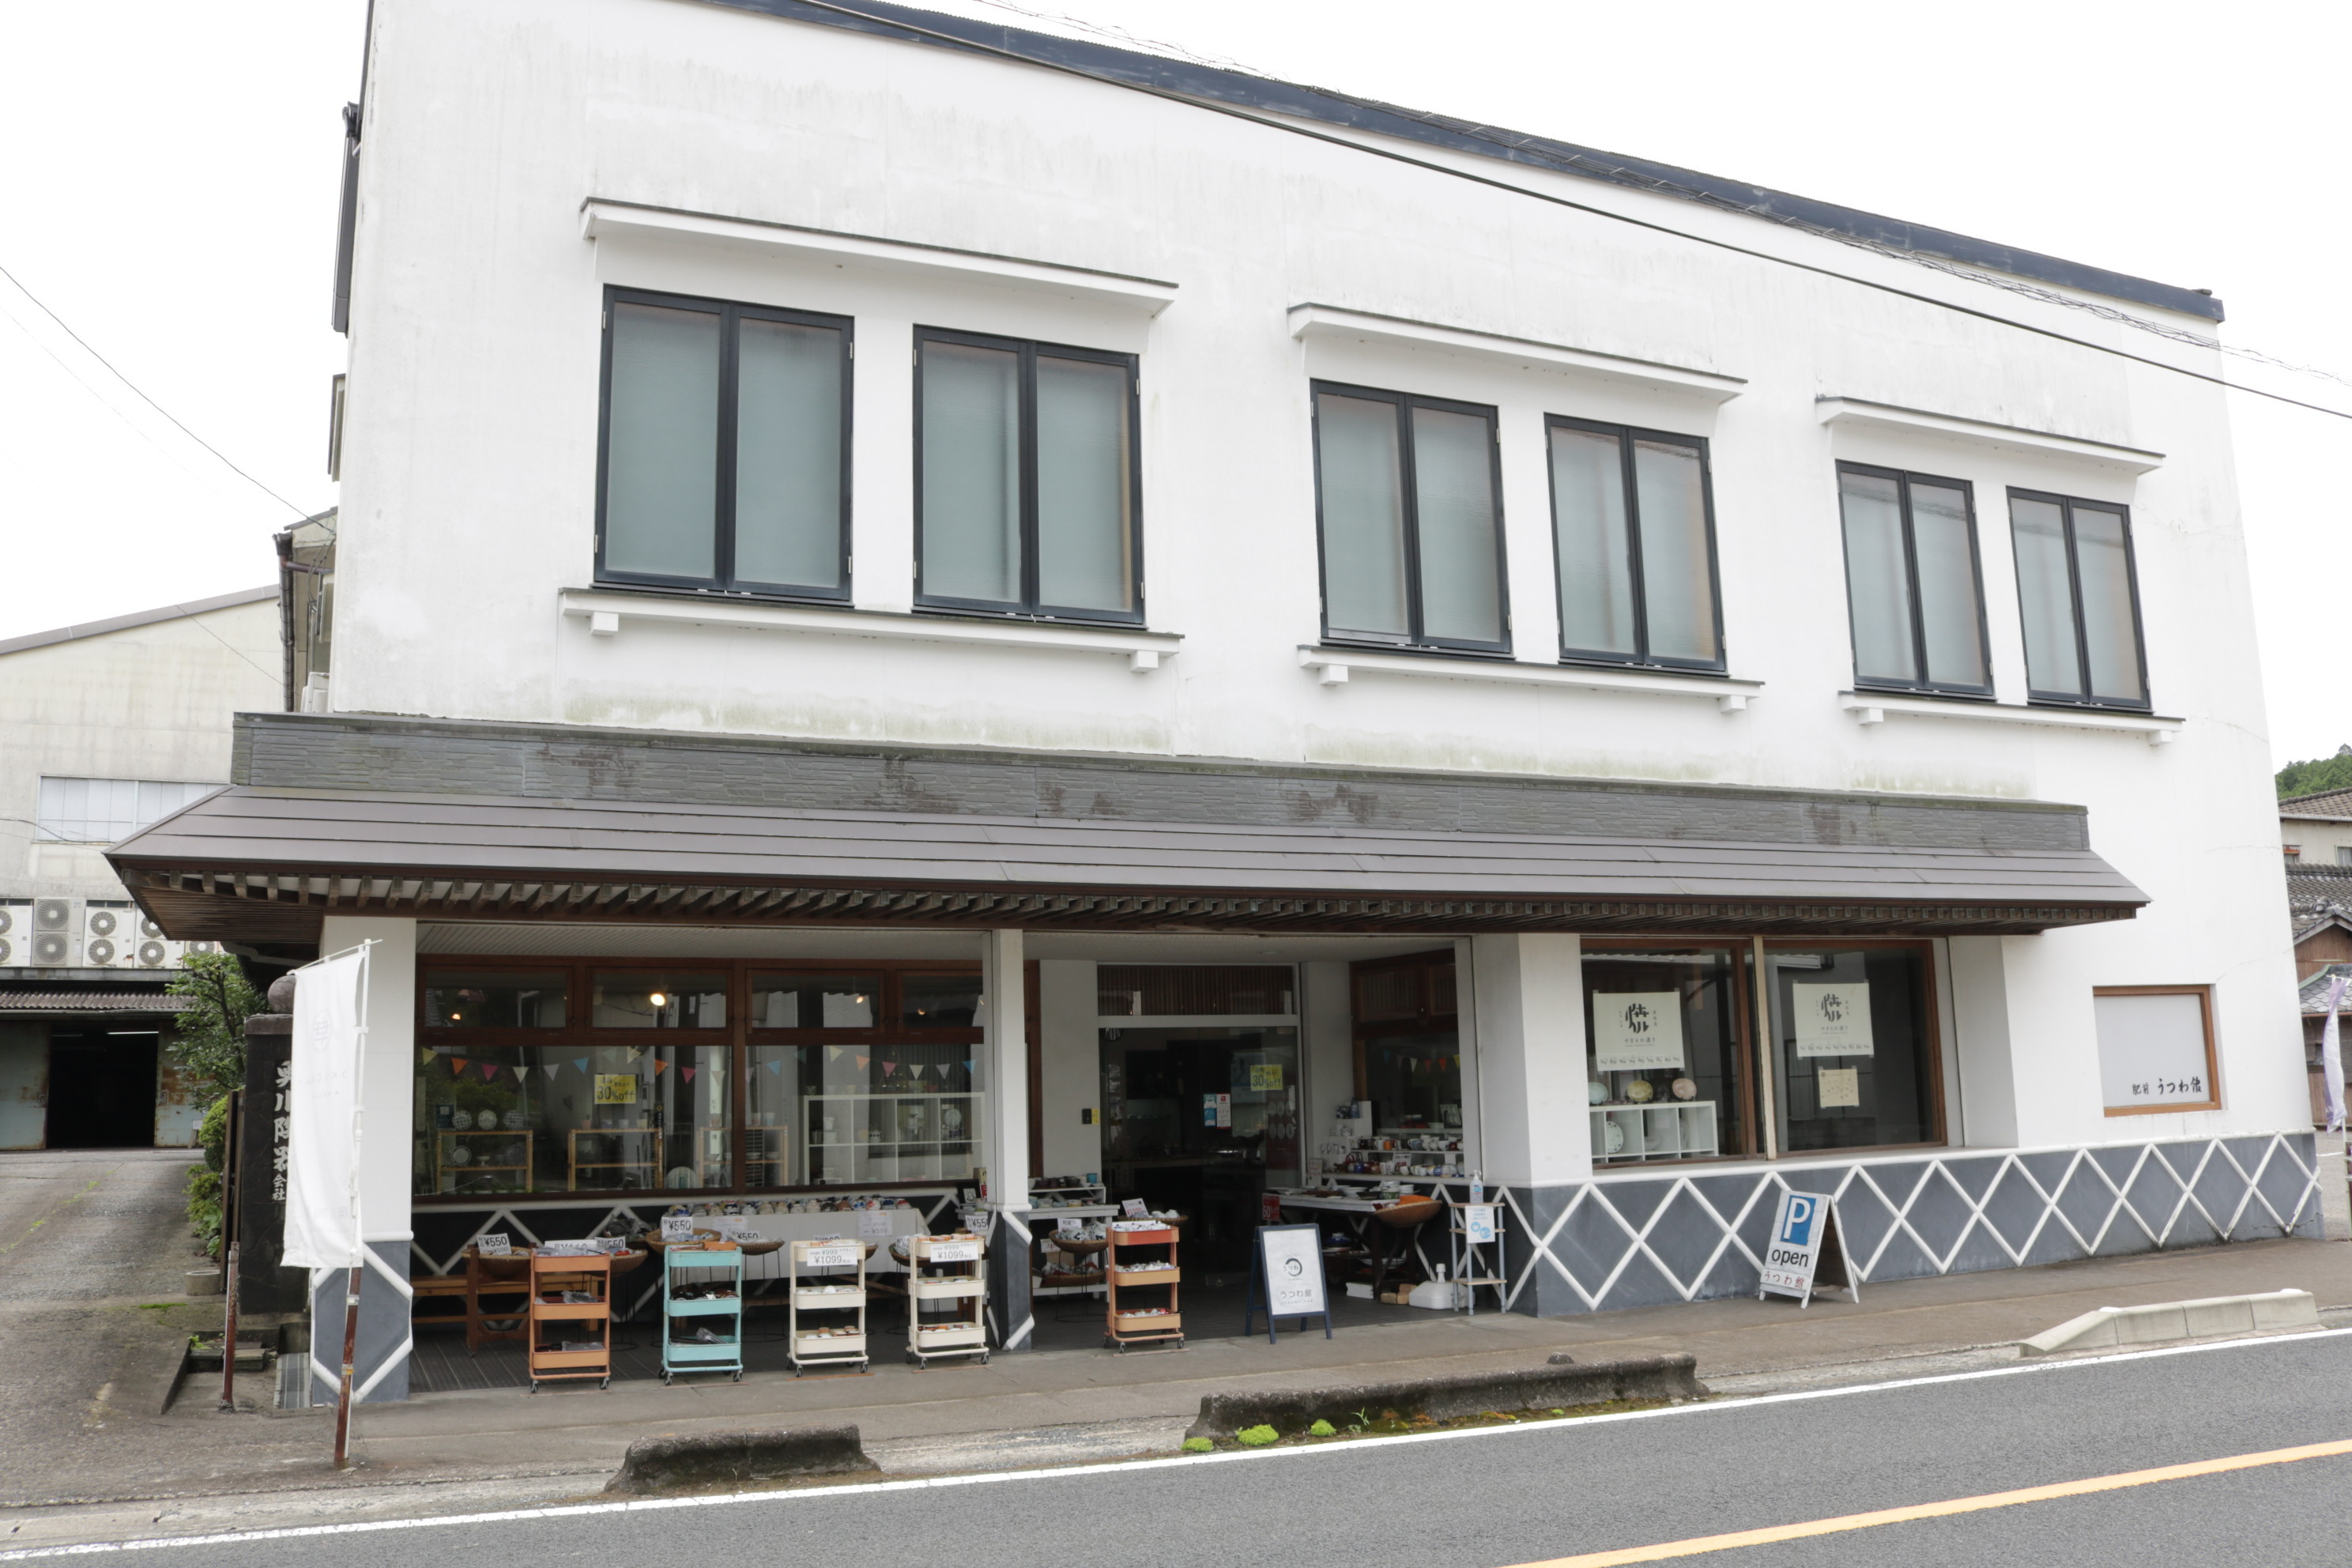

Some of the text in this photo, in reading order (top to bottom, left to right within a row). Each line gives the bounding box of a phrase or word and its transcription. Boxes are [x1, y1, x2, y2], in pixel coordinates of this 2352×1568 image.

[1784, 1197, 1811, 1239] P
[669, 1220, 691, 1231] ¥550
[484, 1236, 507, 1247] ¥550
[814, 1255, 842, 1264] ¥1099
[937, 1250, 963, 1259] ¥1099
[1771, 1249, 1809, 1268] open
[1765, 1271, 1805, 1289] うつわ館
[1280, 1289, 1313, 1299] うつわ館
